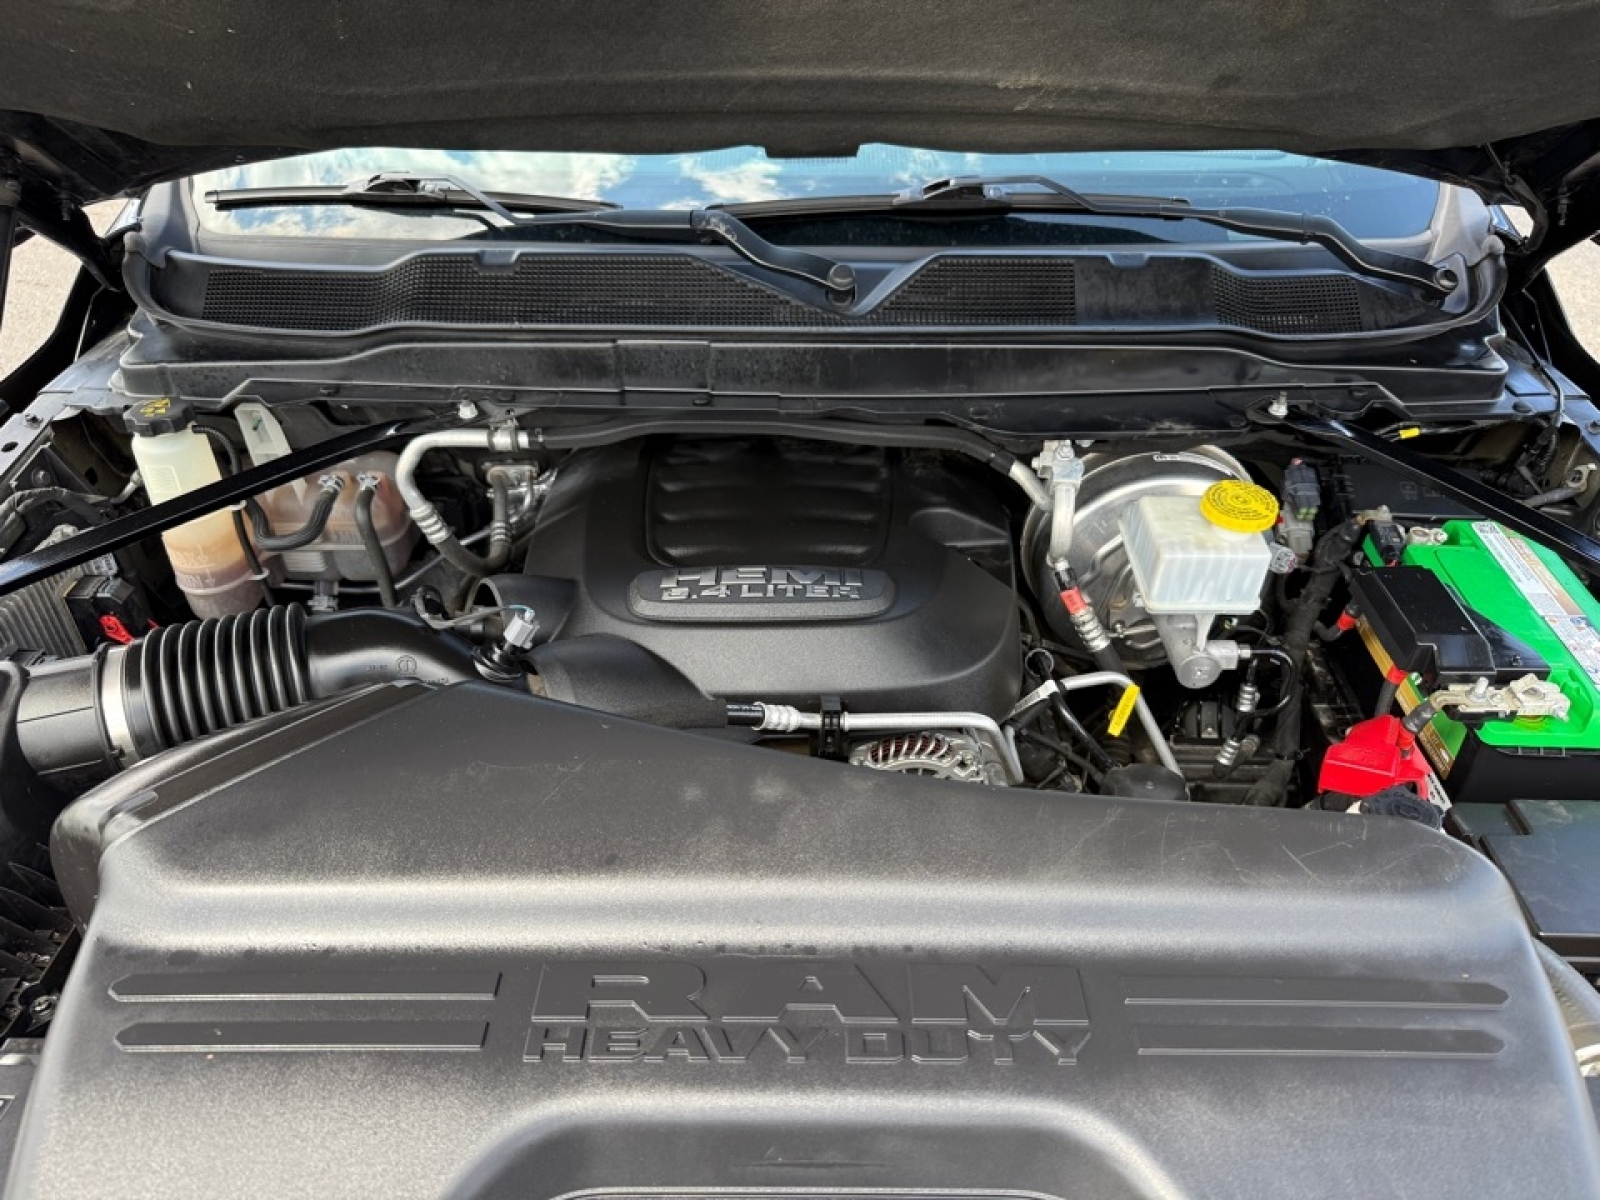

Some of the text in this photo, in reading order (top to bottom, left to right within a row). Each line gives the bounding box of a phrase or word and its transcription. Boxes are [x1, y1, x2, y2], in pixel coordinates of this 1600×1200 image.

[660, 566, 862, 587] HEMI
[740, 584, 860, 598] LITER
[531, 962, 1090, 1024] RAM
[523, 1028, 1091, 1066] HEAVY DUTY
